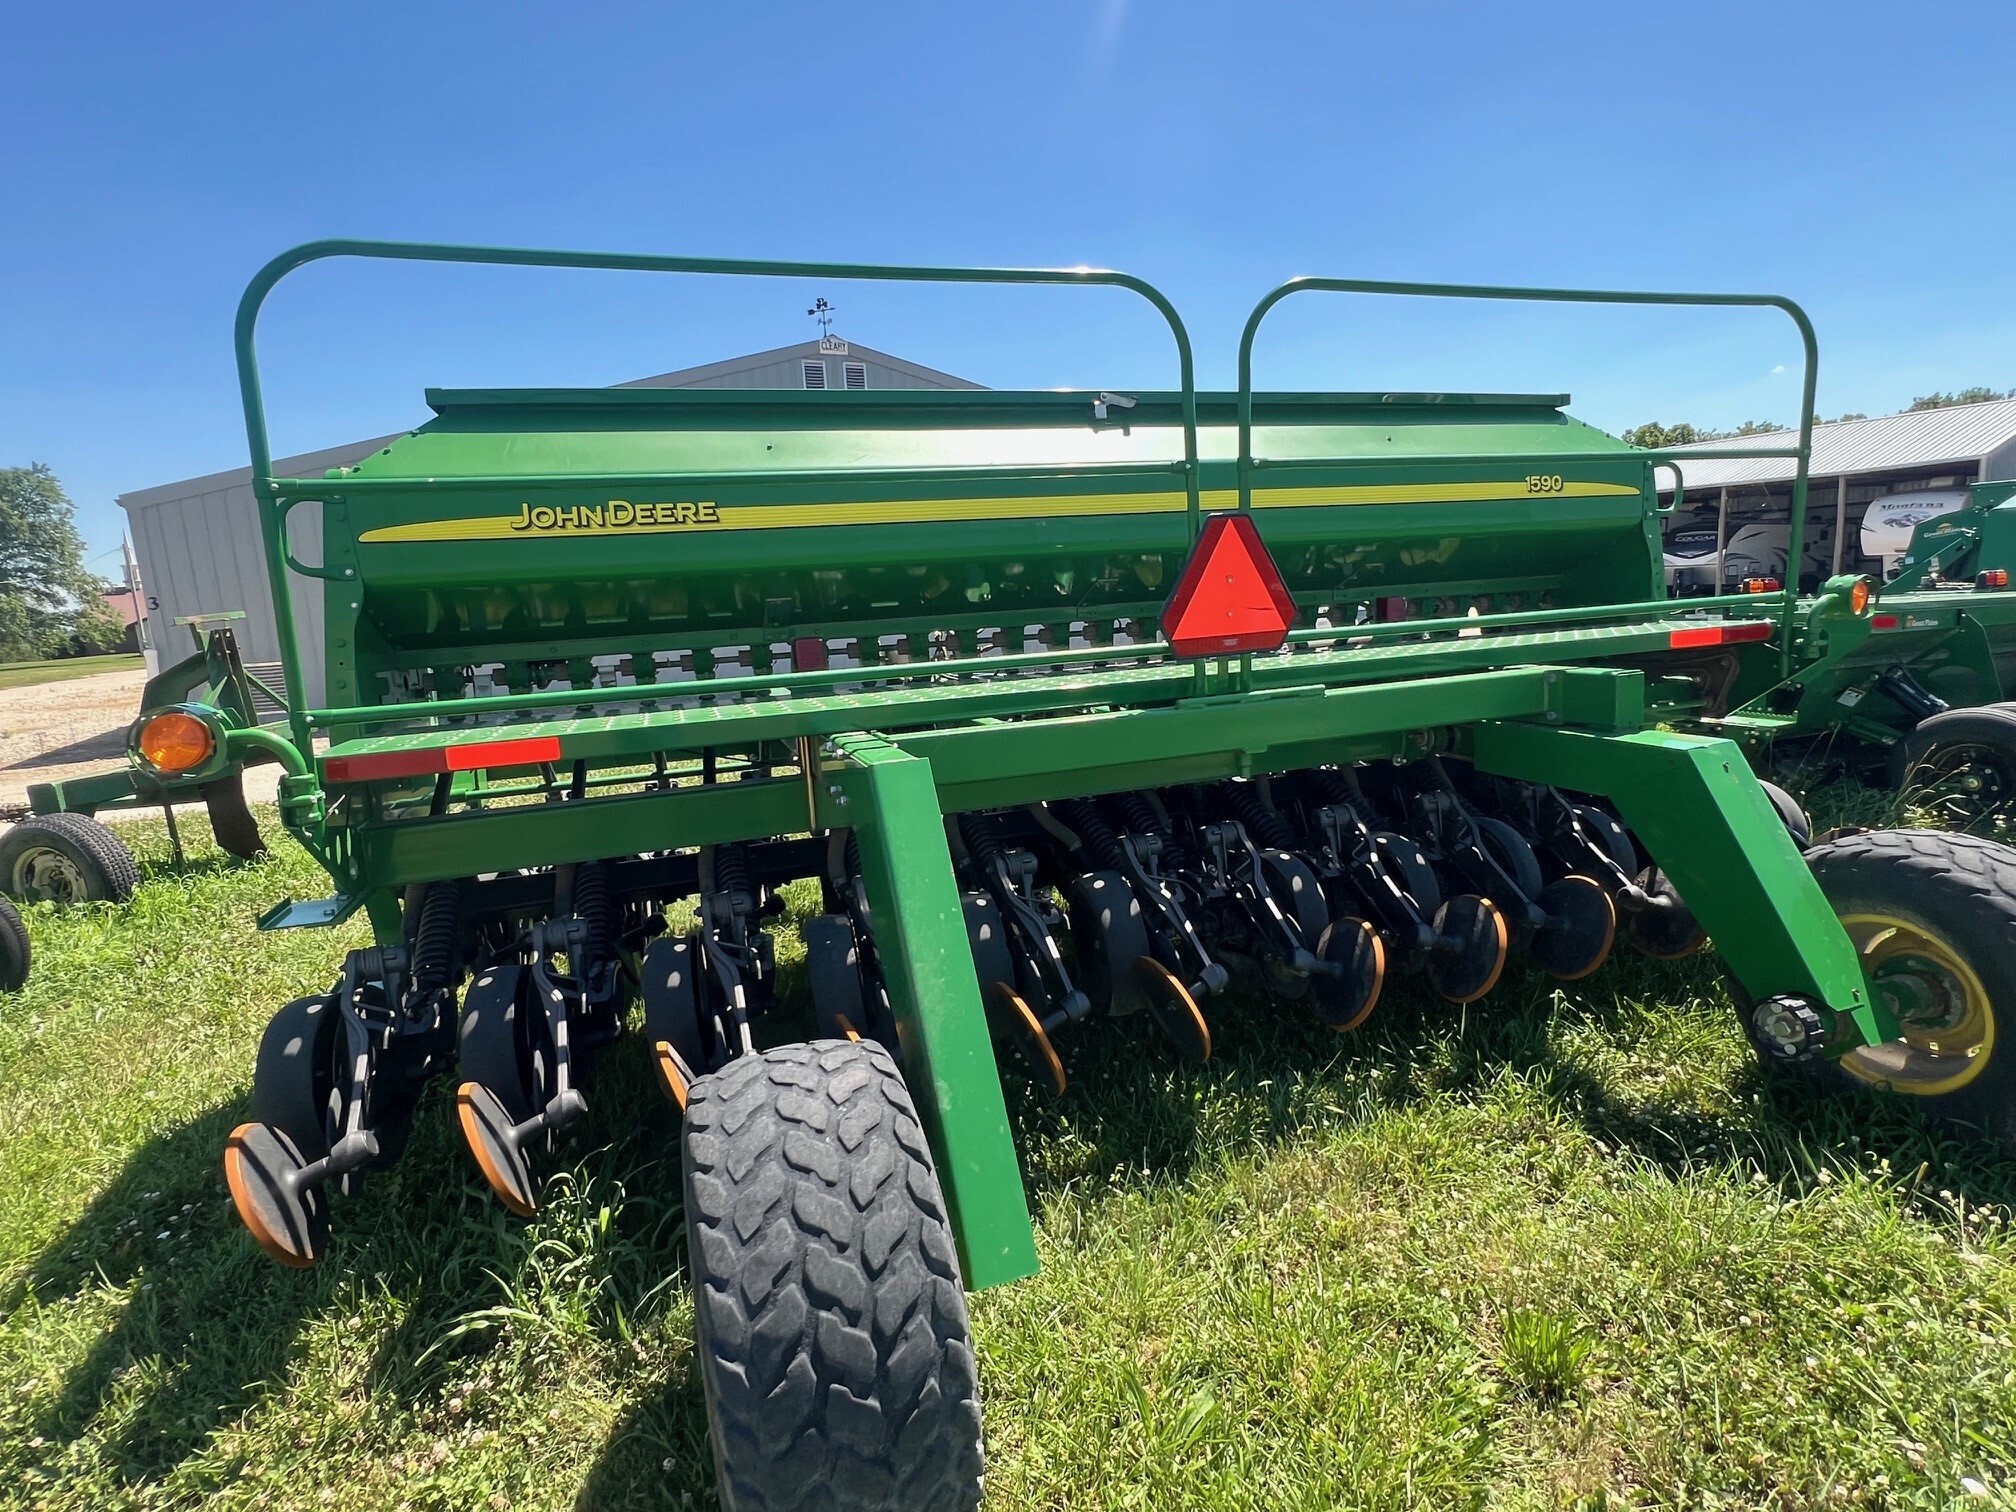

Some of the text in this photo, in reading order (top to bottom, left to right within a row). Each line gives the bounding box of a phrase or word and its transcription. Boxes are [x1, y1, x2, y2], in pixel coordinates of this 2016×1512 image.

[1525, 474, 1563, 491] 1590
[510, 500, 719, 529] JOHN DEERE
[147, 596, 160, 611] 3
